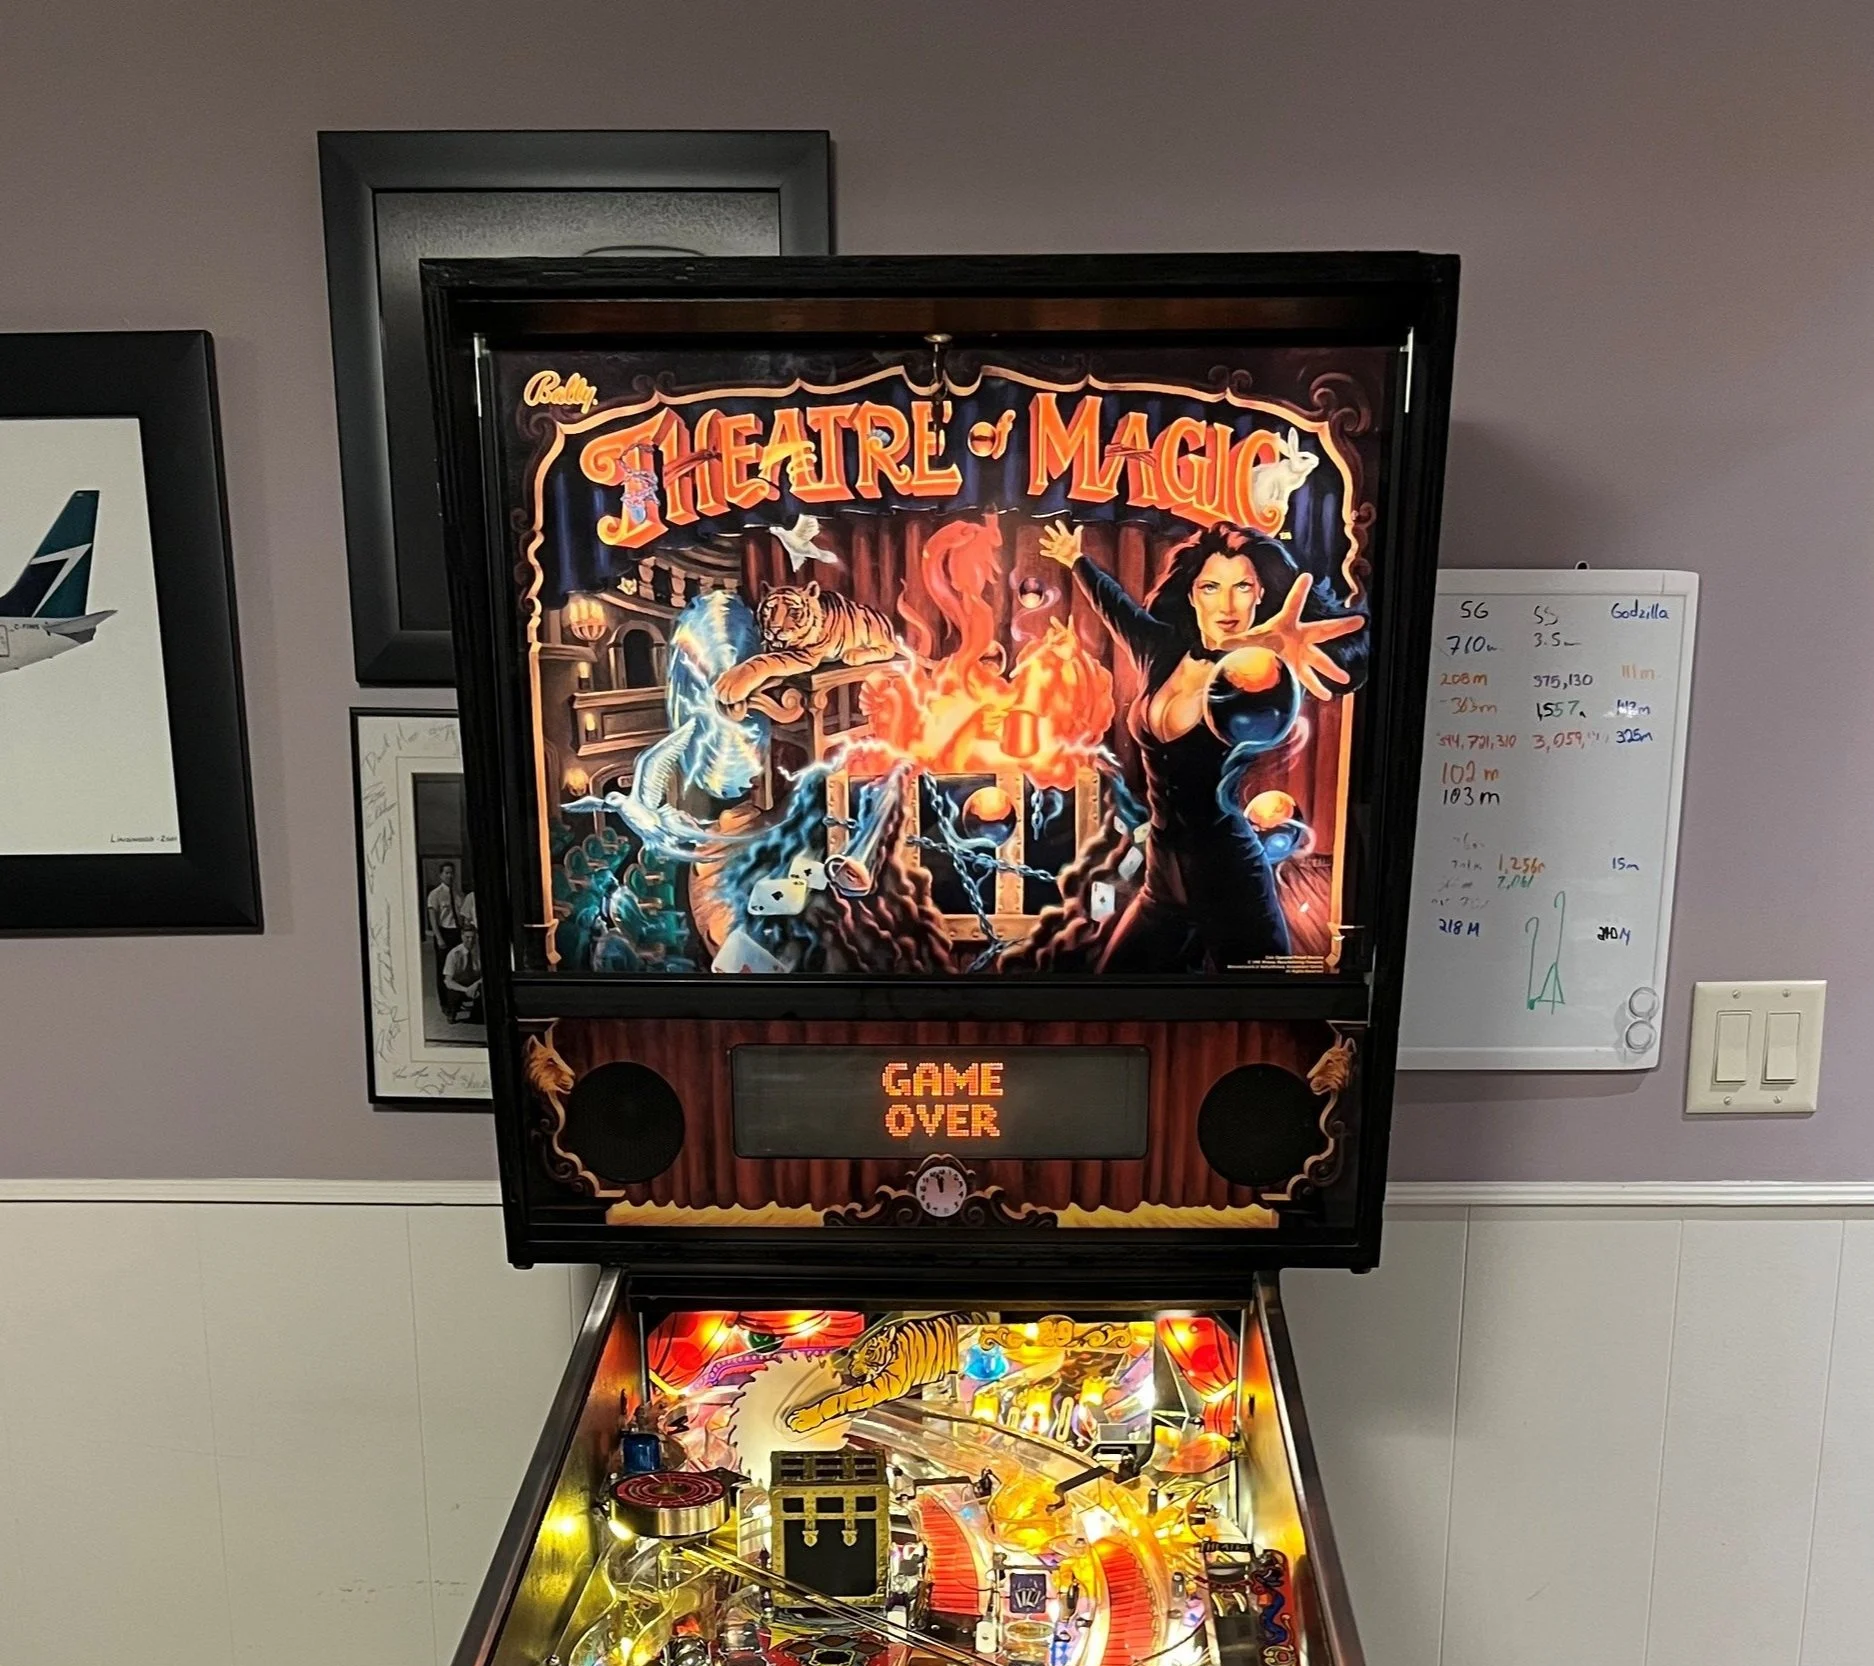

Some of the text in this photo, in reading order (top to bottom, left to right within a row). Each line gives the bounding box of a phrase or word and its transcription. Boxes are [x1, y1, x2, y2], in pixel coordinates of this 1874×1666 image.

[580, 393, 1289, 549] THEATRE of MAGIC
[1610, 599, 1669, 620] Godzilla
[1438, 917, 1462, 936] 218
[882, 1062, 1004, 1096] GAME
[885, 1103, 1001, 1137] OVER
